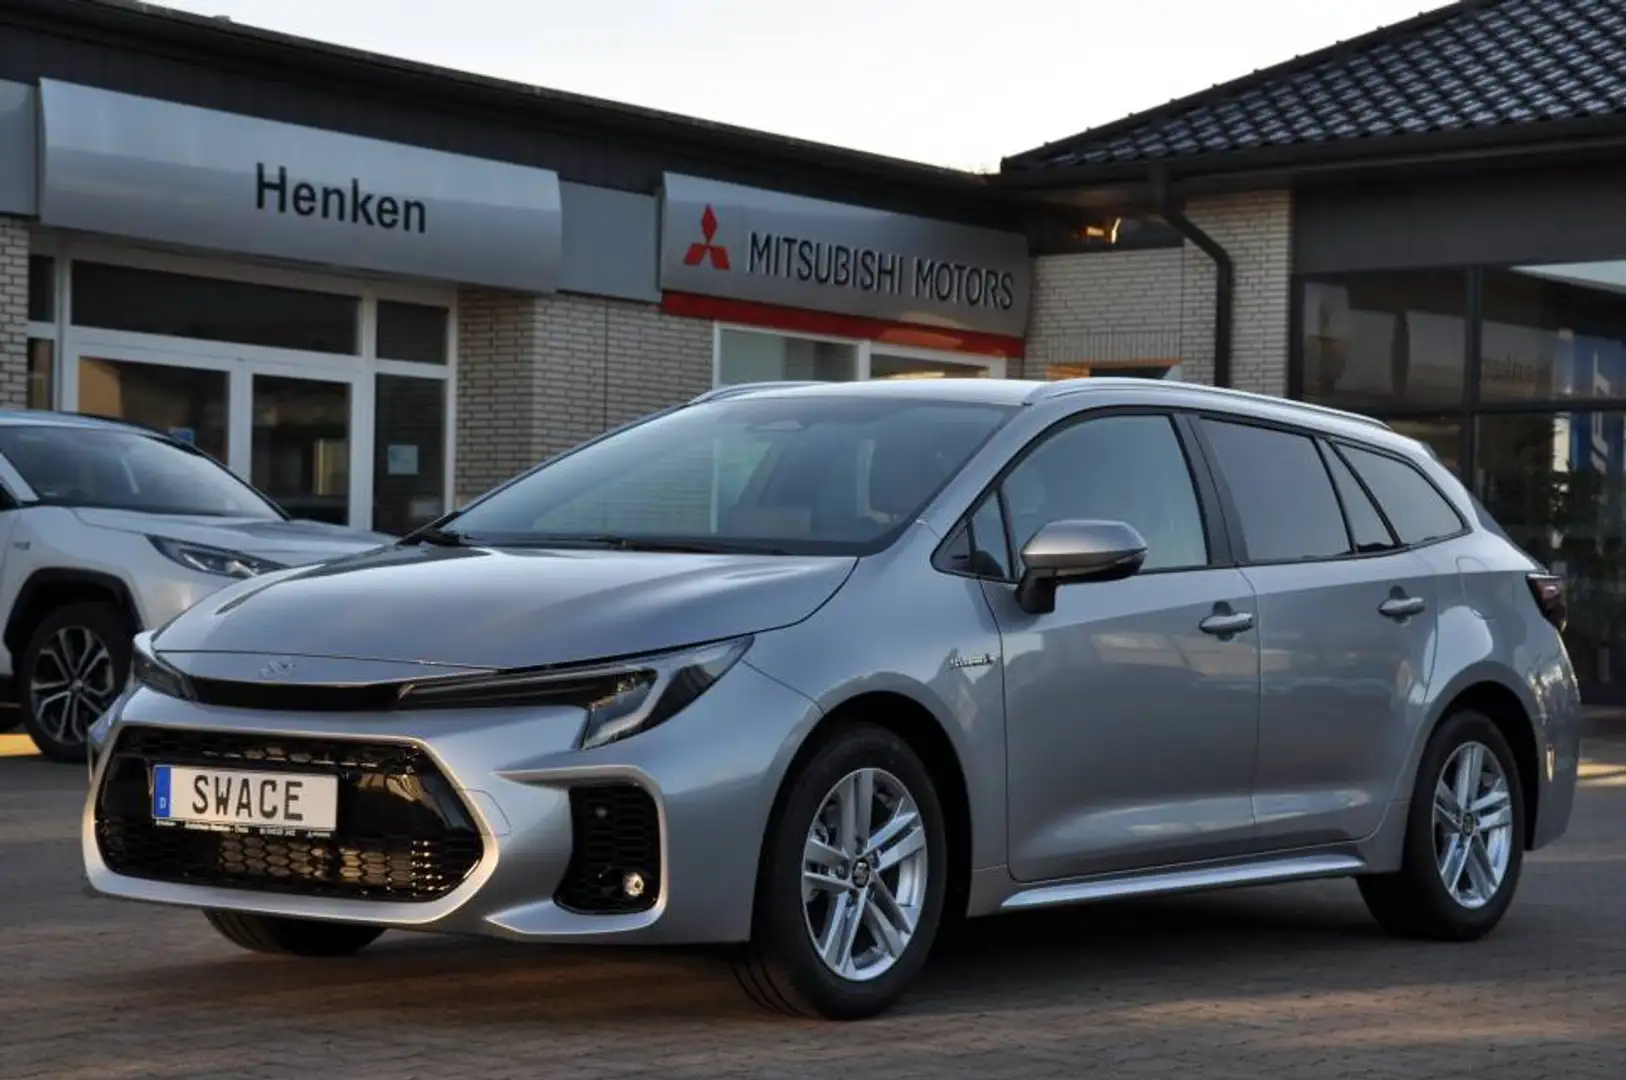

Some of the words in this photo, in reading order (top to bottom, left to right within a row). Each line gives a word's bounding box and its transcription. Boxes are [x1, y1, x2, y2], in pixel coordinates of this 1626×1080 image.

[256, 162, 426, 233] Henken
[748, 231, 906, 296] MITSUBISHI
[911, 257, 1015, 311] MOTORS
[159, 796, 166, 809] D
[192, 775, 303, 821] SWACE
